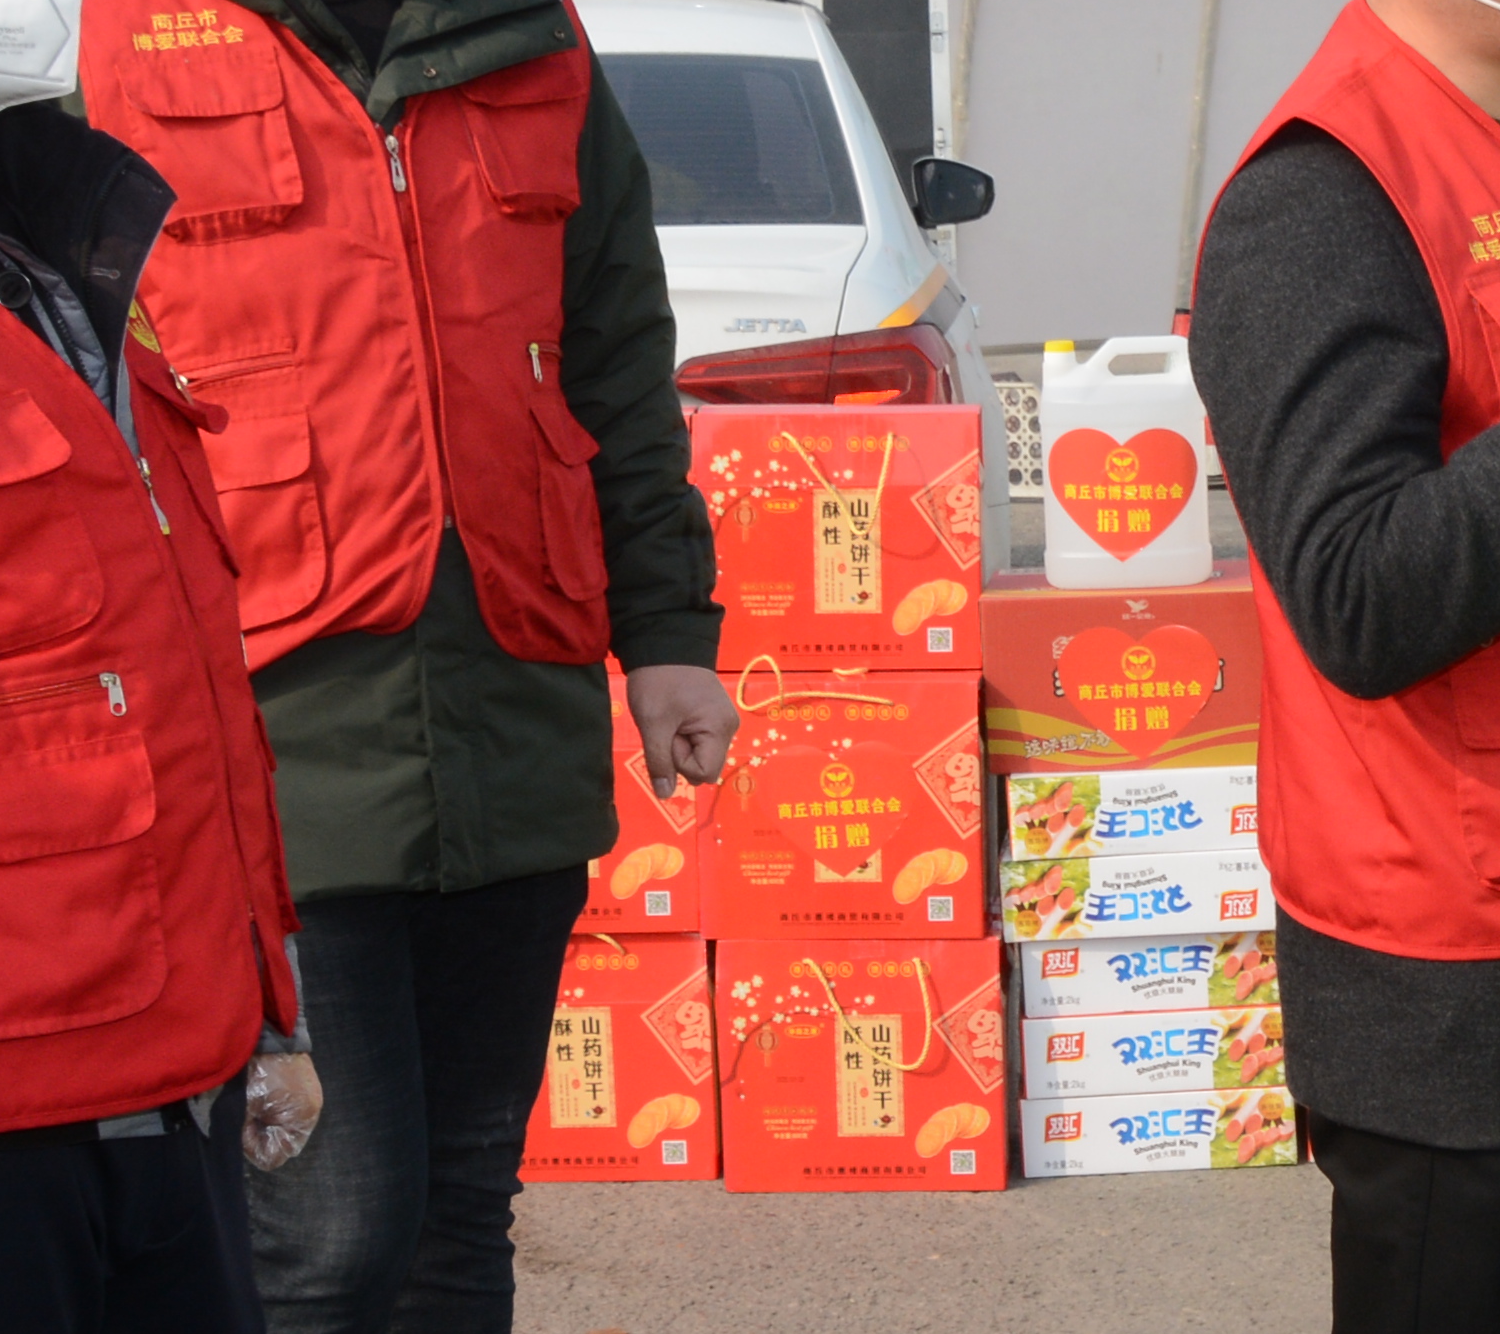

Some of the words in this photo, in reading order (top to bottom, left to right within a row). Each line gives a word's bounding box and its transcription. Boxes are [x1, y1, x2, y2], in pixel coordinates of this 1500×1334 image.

[151, 9, 219, 31] 商丘市
[131, 24, 244, 53] 博爱联合会
[724, 318, 806, 333] JETTA
[1062, 483, 1184, 501] 商丘市博爱联合会
[822, 501, 841, 545] 酥性
[1095, 508, 1151, 534] 捐赠
[1077, 680, 1203, 701] 商丘市博爱联合会
[1113, 705, 1170, 732] 捐赠
[777, 797, 902, 820] 商丘市博爱联合会
[1113, 797, 1132, 808] King
[1134, 789, 1179, 807] Shuanghui
[1095, 800, 1203, 839] 双汇王
[814, 823, 870, 849] 捐赠
[1102, 880, 1121, 891] King
[1123, 874, 1168, 890] Shuanghui
[1085, 884, 1192, 921] 双汇王
[1046, 952, 1075, 970] 双汇
[1107, 945, 1214, 983] 双汇王
[1131, 977, 1175, 993] Shuanghui
[1176, 976, 1196, 987] King
[1052, 1036, 1081, 1054] 双汇
[1112, 1028, 1219, 1066] 双汇王
[582, 1016, 604, 1101] 山药饼干
[872, 1023, 893, 1110] 山药饼干
[1136, 1061, 1180, 1077] Shuanghui
[1182, 1059, 1201, 1070] King
[1049, 1116, 1079, 1134] 双汇
[1110, 1109, 1216, 1146] 双汇王
[1134, 1141, 1177, 1157] Shuanghui
[1179, 1139, 1198, 1150] King
